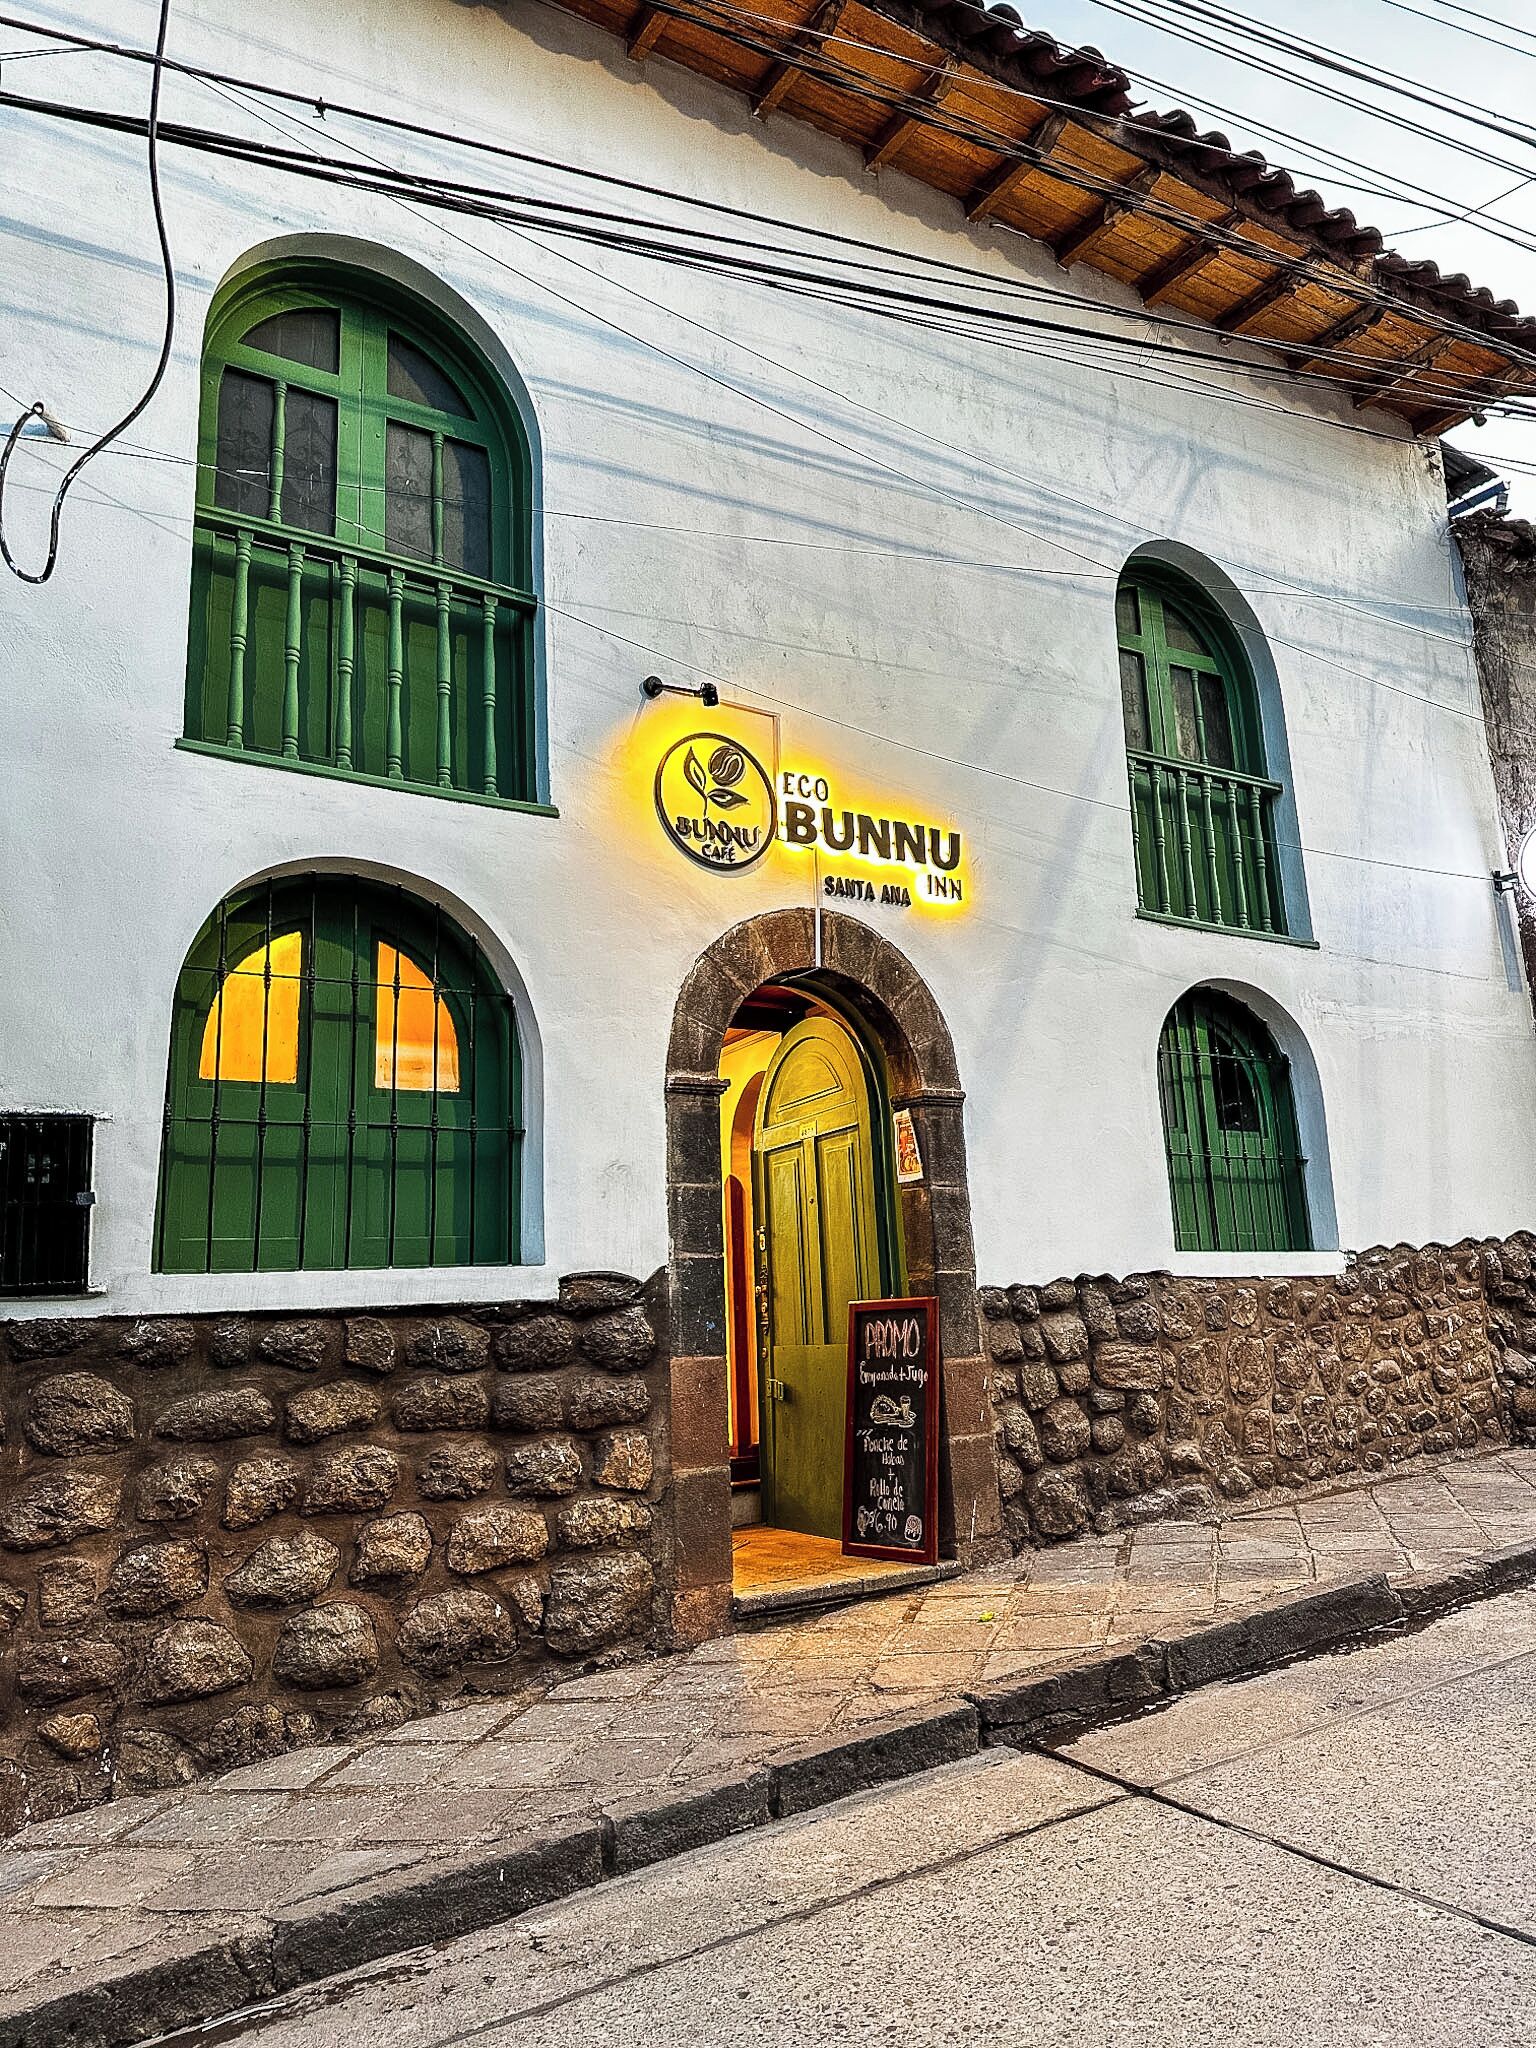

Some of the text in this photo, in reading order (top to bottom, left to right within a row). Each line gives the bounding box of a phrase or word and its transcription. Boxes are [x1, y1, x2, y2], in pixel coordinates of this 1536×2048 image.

[783, 772, 829, 802] ECO
[676, 815, 759, 852] BUNNU
[785, 801, 961, 871] BUNNU
[824, 876, 912, 908] SANTA ANA
[927, 874, 963, 901] INN
[865, 1318, 921, 1360] PROMO
[863, 1433, 908, 1453] Ponche de
[893, 1476, 904, 1498] de
